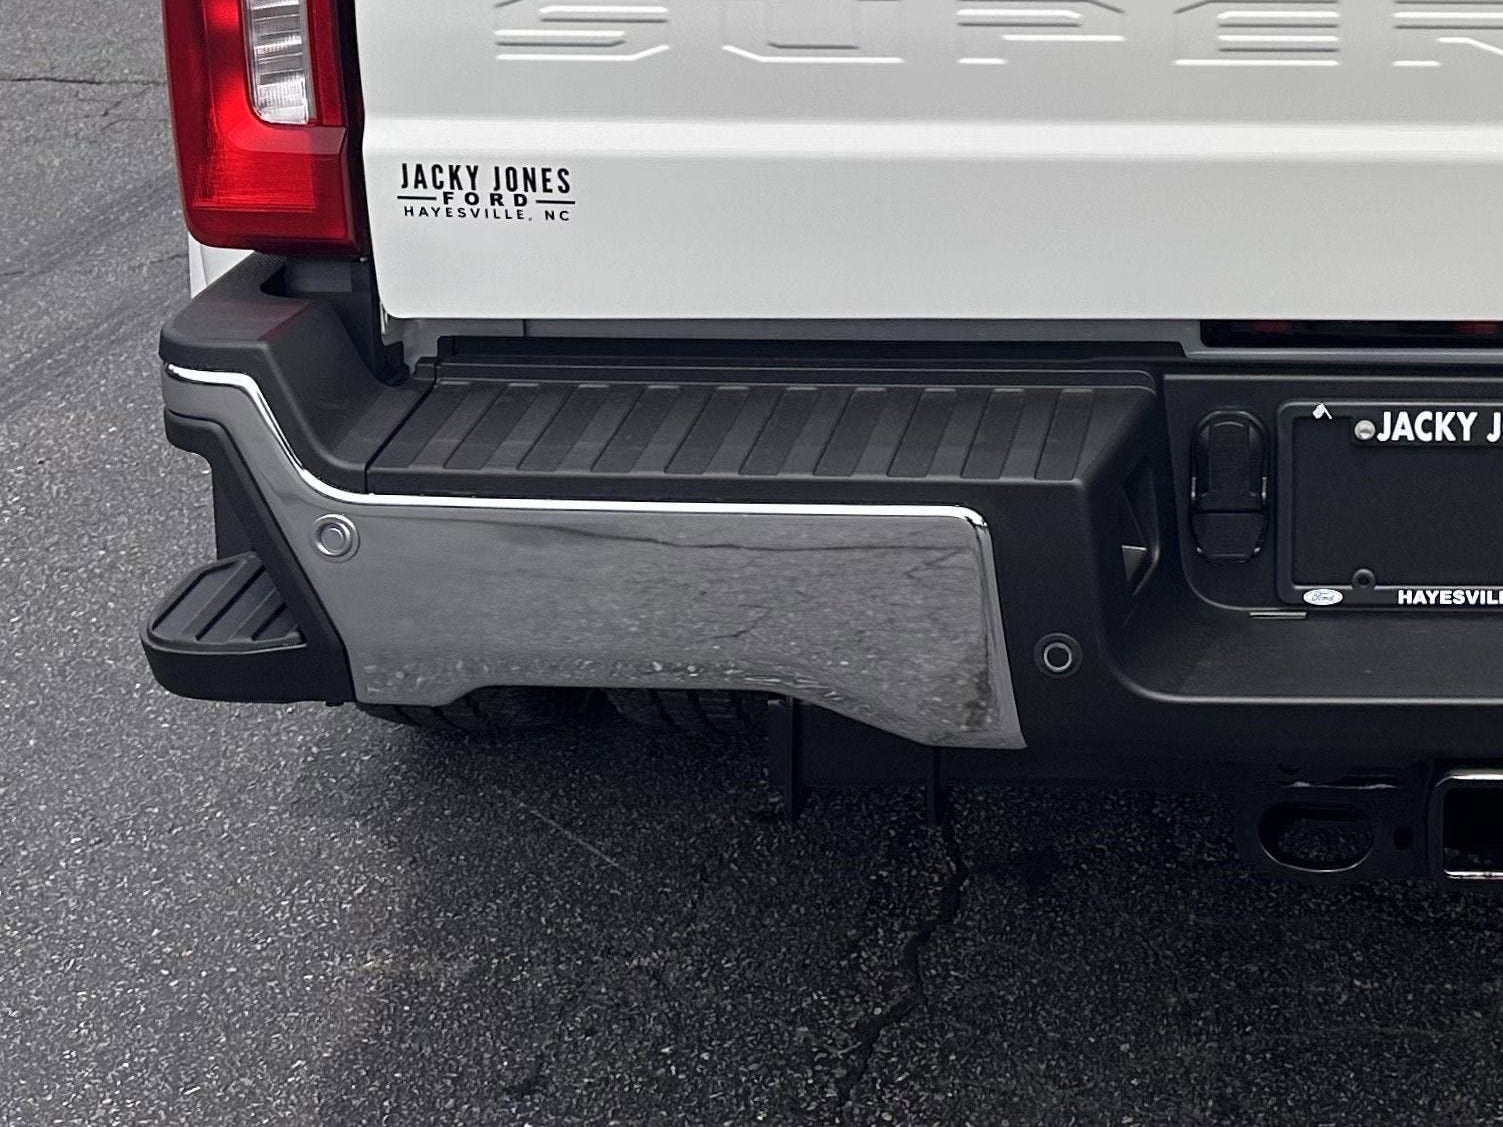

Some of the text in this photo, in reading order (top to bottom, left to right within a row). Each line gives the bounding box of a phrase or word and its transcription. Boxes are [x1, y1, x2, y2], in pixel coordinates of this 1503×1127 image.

[401, 163, 571, 194] JACKY JONES
[443, 191, 528, 206] FORD
[544, 210, 570, 222] NC
[1376, 411, 1477, 442] JACKY
